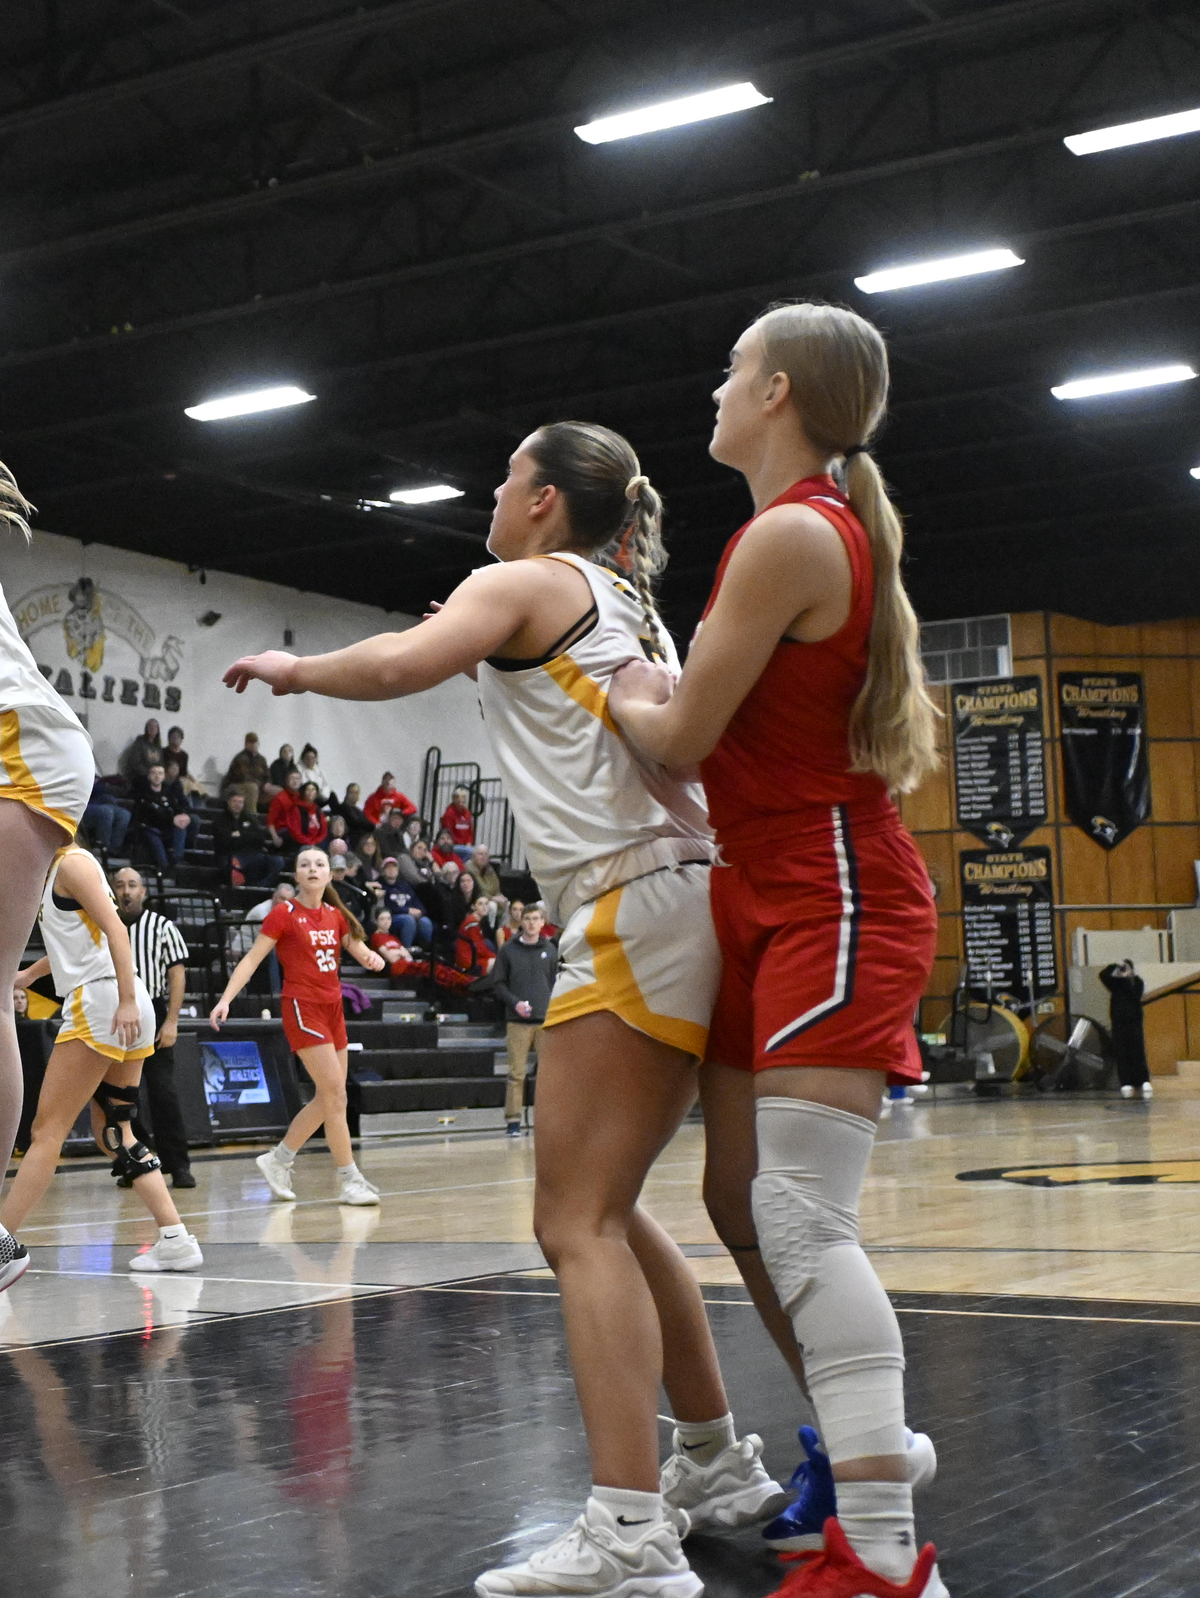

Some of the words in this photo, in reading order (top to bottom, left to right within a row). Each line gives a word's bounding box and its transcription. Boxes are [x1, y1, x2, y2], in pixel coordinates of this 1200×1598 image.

[16, 594, 62, 633] HOME
[37, 663, 182, 713] VALIERS
[978, 684, 1015, 696] STATE
[1062, 684, 1139, 705] CHAMPIONS
[956, 688, 1039, 713] CHAMPIONS
[986, 852, 1023, 863] STATE
[965, 858, 1047, 881] CHAMPIONS
[978, 882, 1033, 897] Wrestling
[308, 929, 338, 946] FSK
[315, 948, 337, 973] 25
